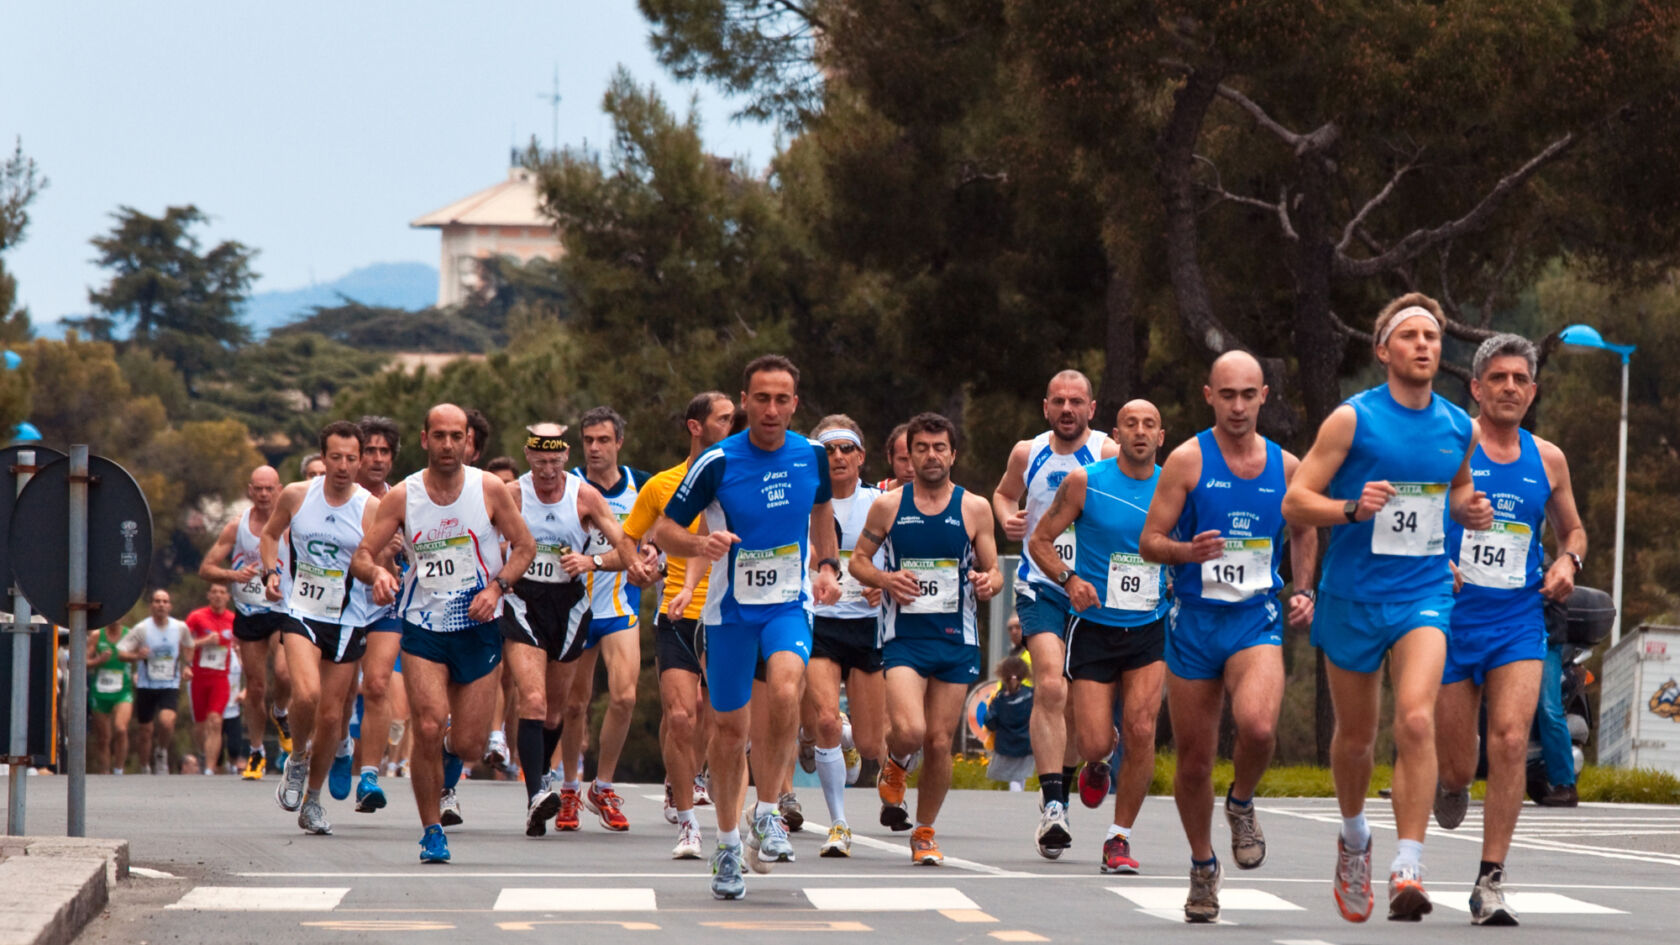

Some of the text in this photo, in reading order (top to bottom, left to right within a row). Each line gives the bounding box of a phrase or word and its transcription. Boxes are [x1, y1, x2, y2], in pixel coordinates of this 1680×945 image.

[767, 488, 785, 501] GAU
[1497, 498, 1515, 511] GAU
[1232, 516, 1250, 529] GAU
[1392, 510, 1417, 533] 34
[307, 540, 339, 560] CR
[1472, 544, 1506, 567] 154
[425, 558, 455, 578] 210
[527, 561, 553, 577] 310
[1212, 564, 1245, 584] 161
[744, 569, 778, 587] 159
[1120, 575, 1140, 593] 69
[242, 582, 262, 595] 256
[299, 581, 325, 601] 317
